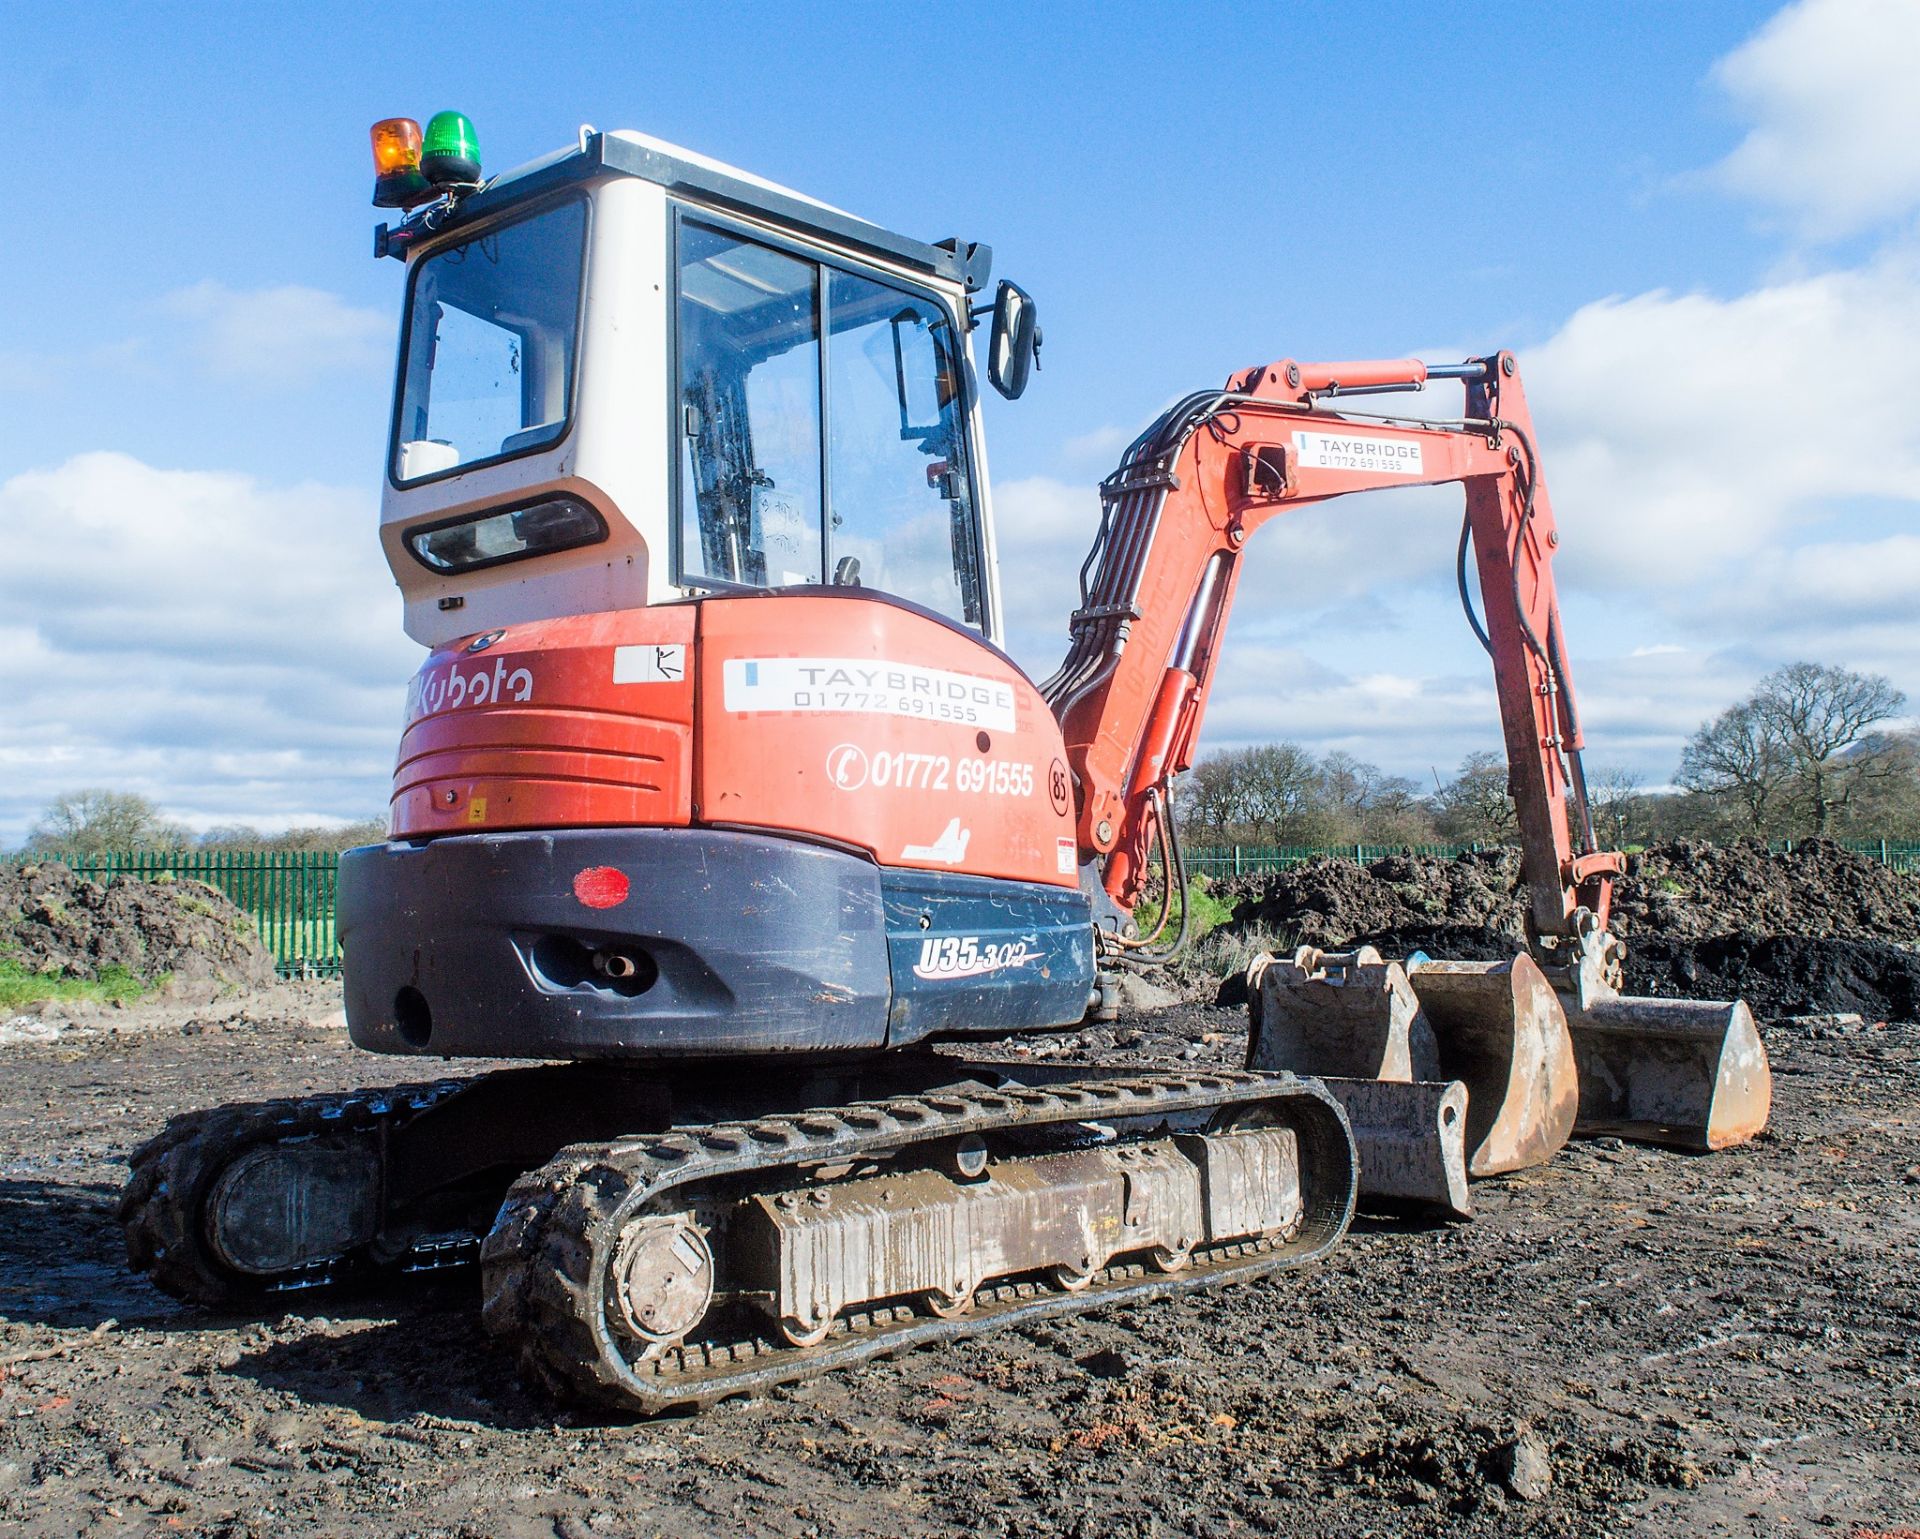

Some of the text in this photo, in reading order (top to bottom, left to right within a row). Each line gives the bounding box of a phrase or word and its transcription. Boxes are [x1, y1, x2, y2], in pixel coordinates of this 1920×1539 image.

[1320, 440, 1419, 459] TAYBRIDGE
[1320, 455, 1402, 471] 01772 691555
[417, 657, 533, 714] Kubota
[798, 668, 1011, 709] TAYBRIDGE
[794, 691, 977, 722] 01772 691555
[871, 751, 1034, 797] 01772 691555
[1053, 770, 1066, 801] 85
